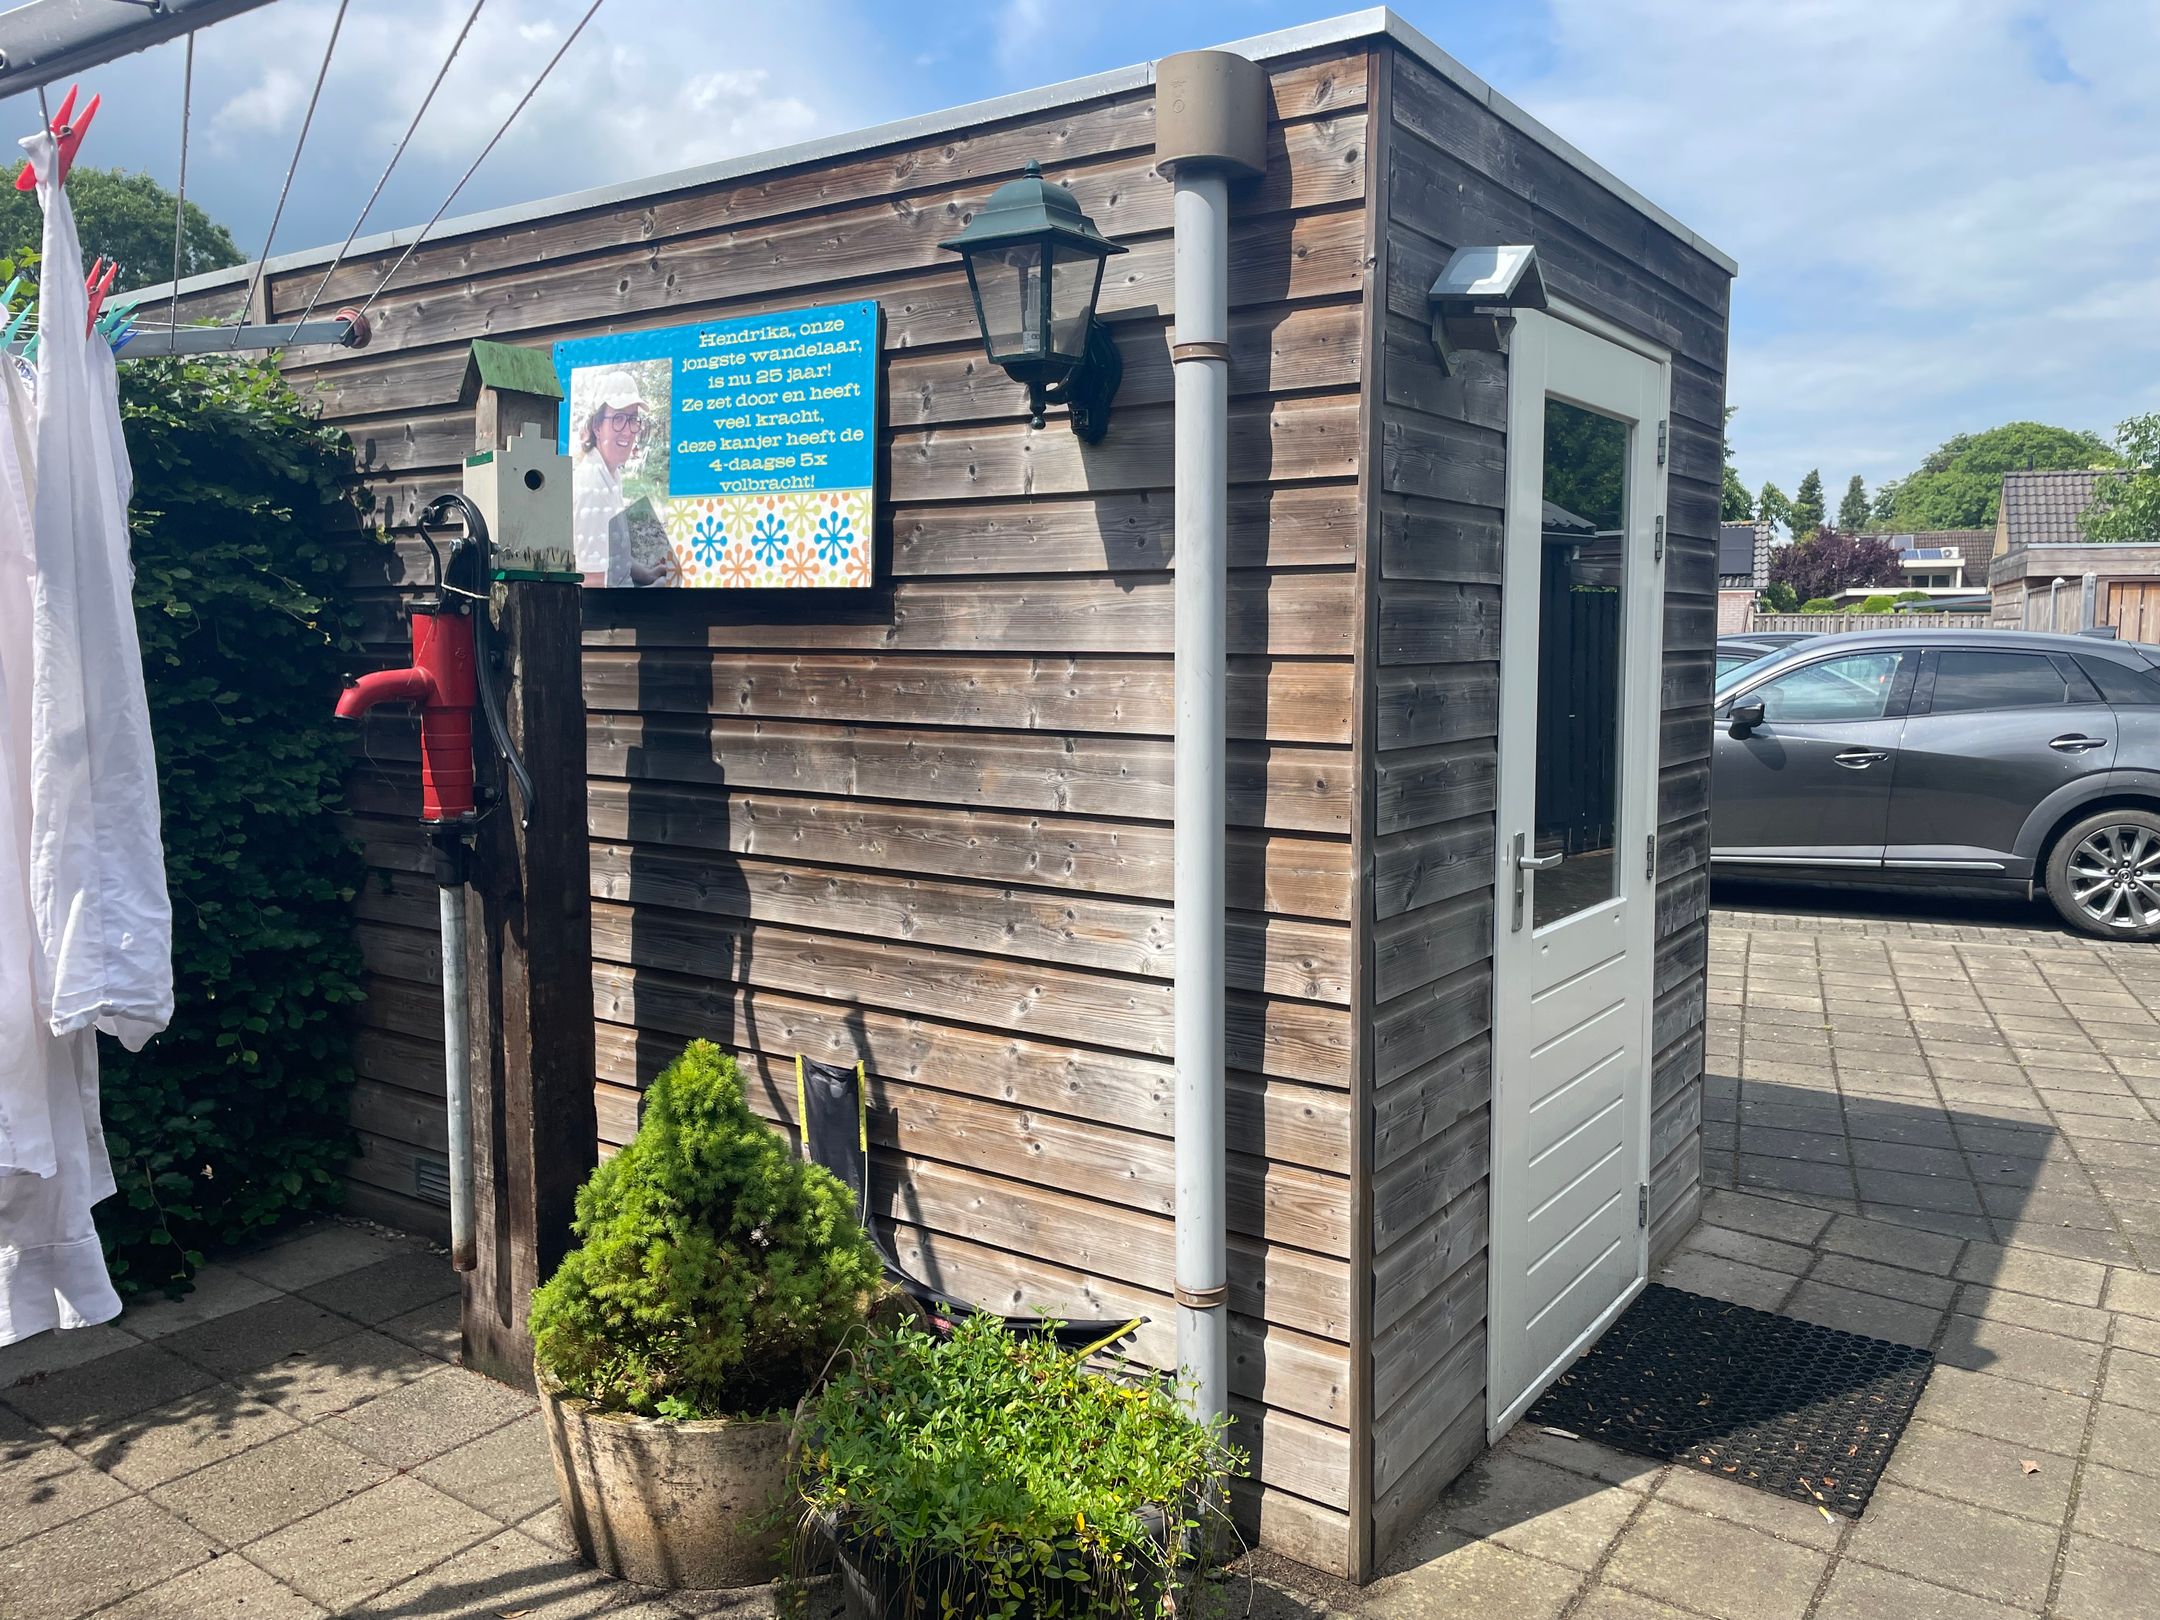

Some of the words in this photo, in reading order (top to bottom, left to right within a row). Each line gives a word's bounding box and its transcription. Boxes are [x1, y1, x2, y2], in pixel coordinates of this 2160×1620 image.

[699, 325, 796, 348] Hendrika,
[800, 319, 845, 335] onze
[681, 353, 746, 373] jongste
[750, 338, 863, 361] wandelaar,
[708, 375, 724, 389] is
[728, 373, 752, 387] nu
[756, 369, 783, 384] 25
[787, 364, 832, 382] jaar!
[682, 399, 704, 411] Ze
[707, 396, 732, 410] zet
[736, 391, 779, 407] door
[783, 388, 806, 403] en
[809, 383, 860, 398] heeft
[713, 414, 752, 429] veel
[755, 410, 825, 427] kracht,
[677, 438, 716, 453] deze
[719, 434, 782, 452] kanjer
[786, 431, 837, 446] heeft
[840, 429, 864, 442] de
[708, 456, 796, 473] 4-daagse
[800, 453, 828, 466] 5x
[719, 476, 815, 493] volbracht!
